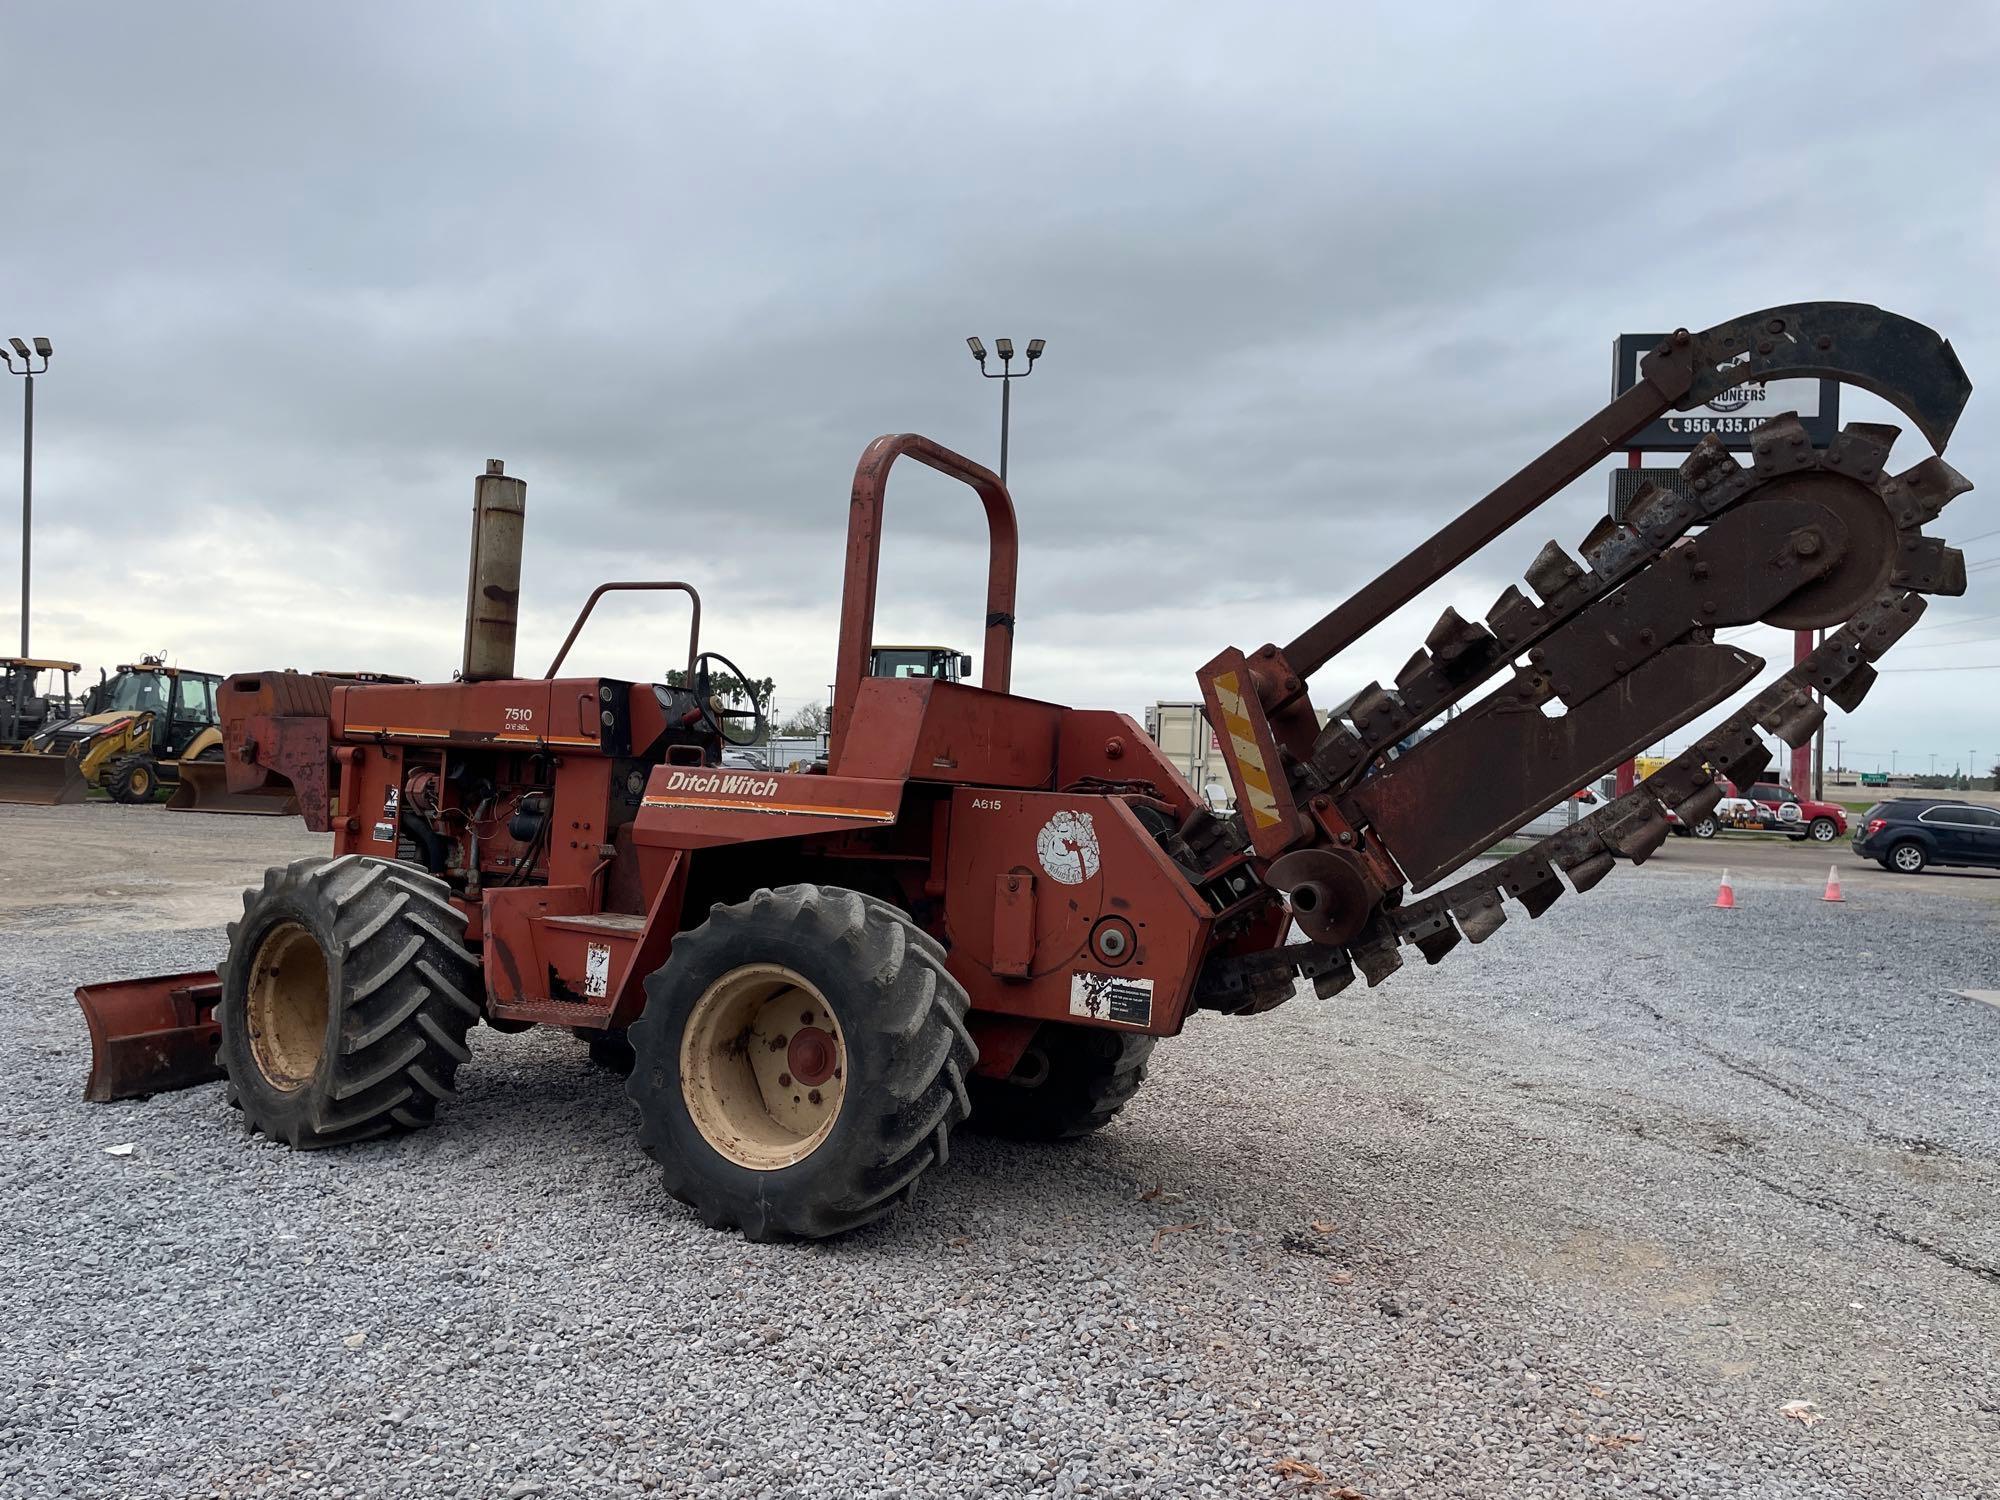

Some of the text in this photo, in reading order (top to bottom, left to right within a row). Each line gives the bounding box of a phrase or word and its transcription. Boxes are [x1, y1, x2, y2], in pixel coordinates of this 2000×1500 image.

[1714, 388, 1766, 402] IONEERS
[505, 707, 533, 721] 7510
[666, 771, 779, 796] Ditch Witch
[972, 798, 1002, 810] A615
